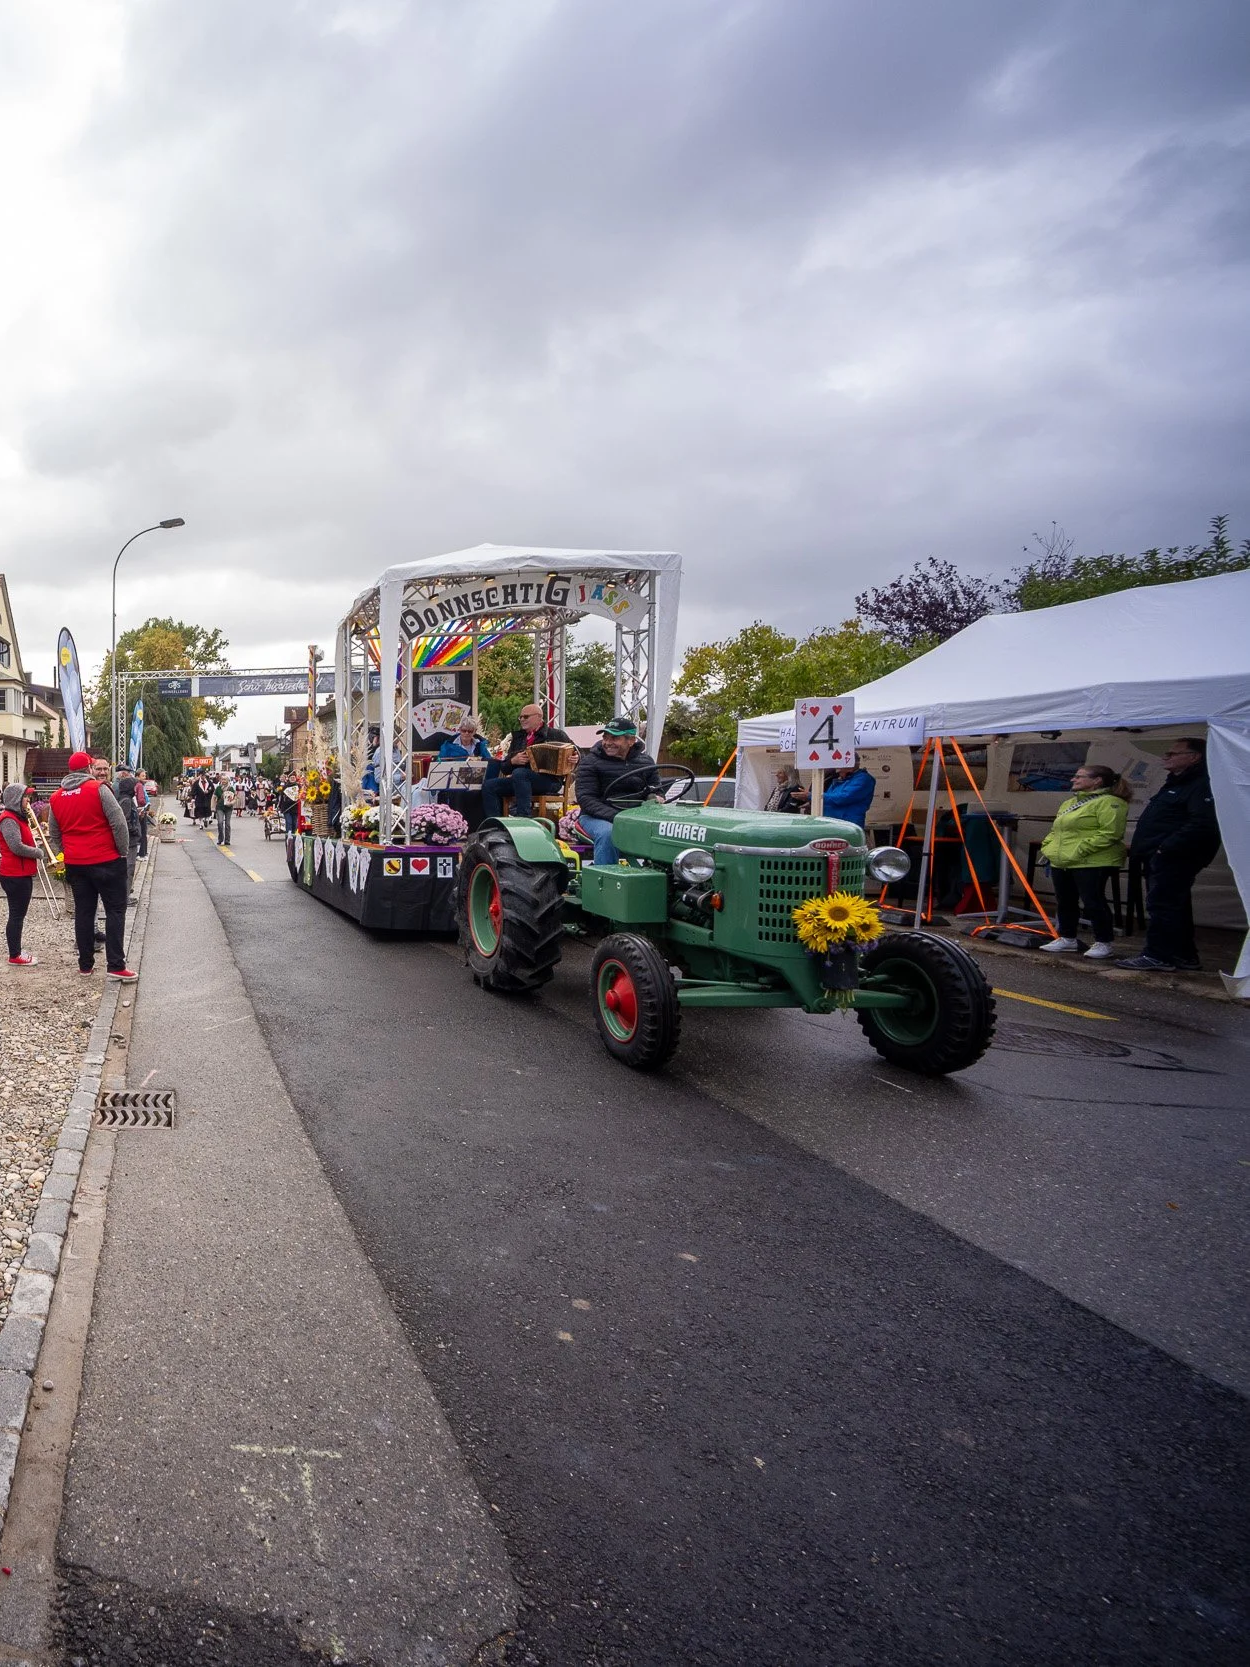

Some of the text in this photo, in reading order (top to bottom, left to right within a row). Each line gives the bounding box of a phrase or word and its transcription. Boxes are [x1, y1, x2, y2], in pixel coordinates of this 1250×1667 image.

[400, 575, 630, 641] DONNSCHTIG JASS
[809, 715, 839, 750] 4
[854, 717, 918, 731] ZENTRUM
